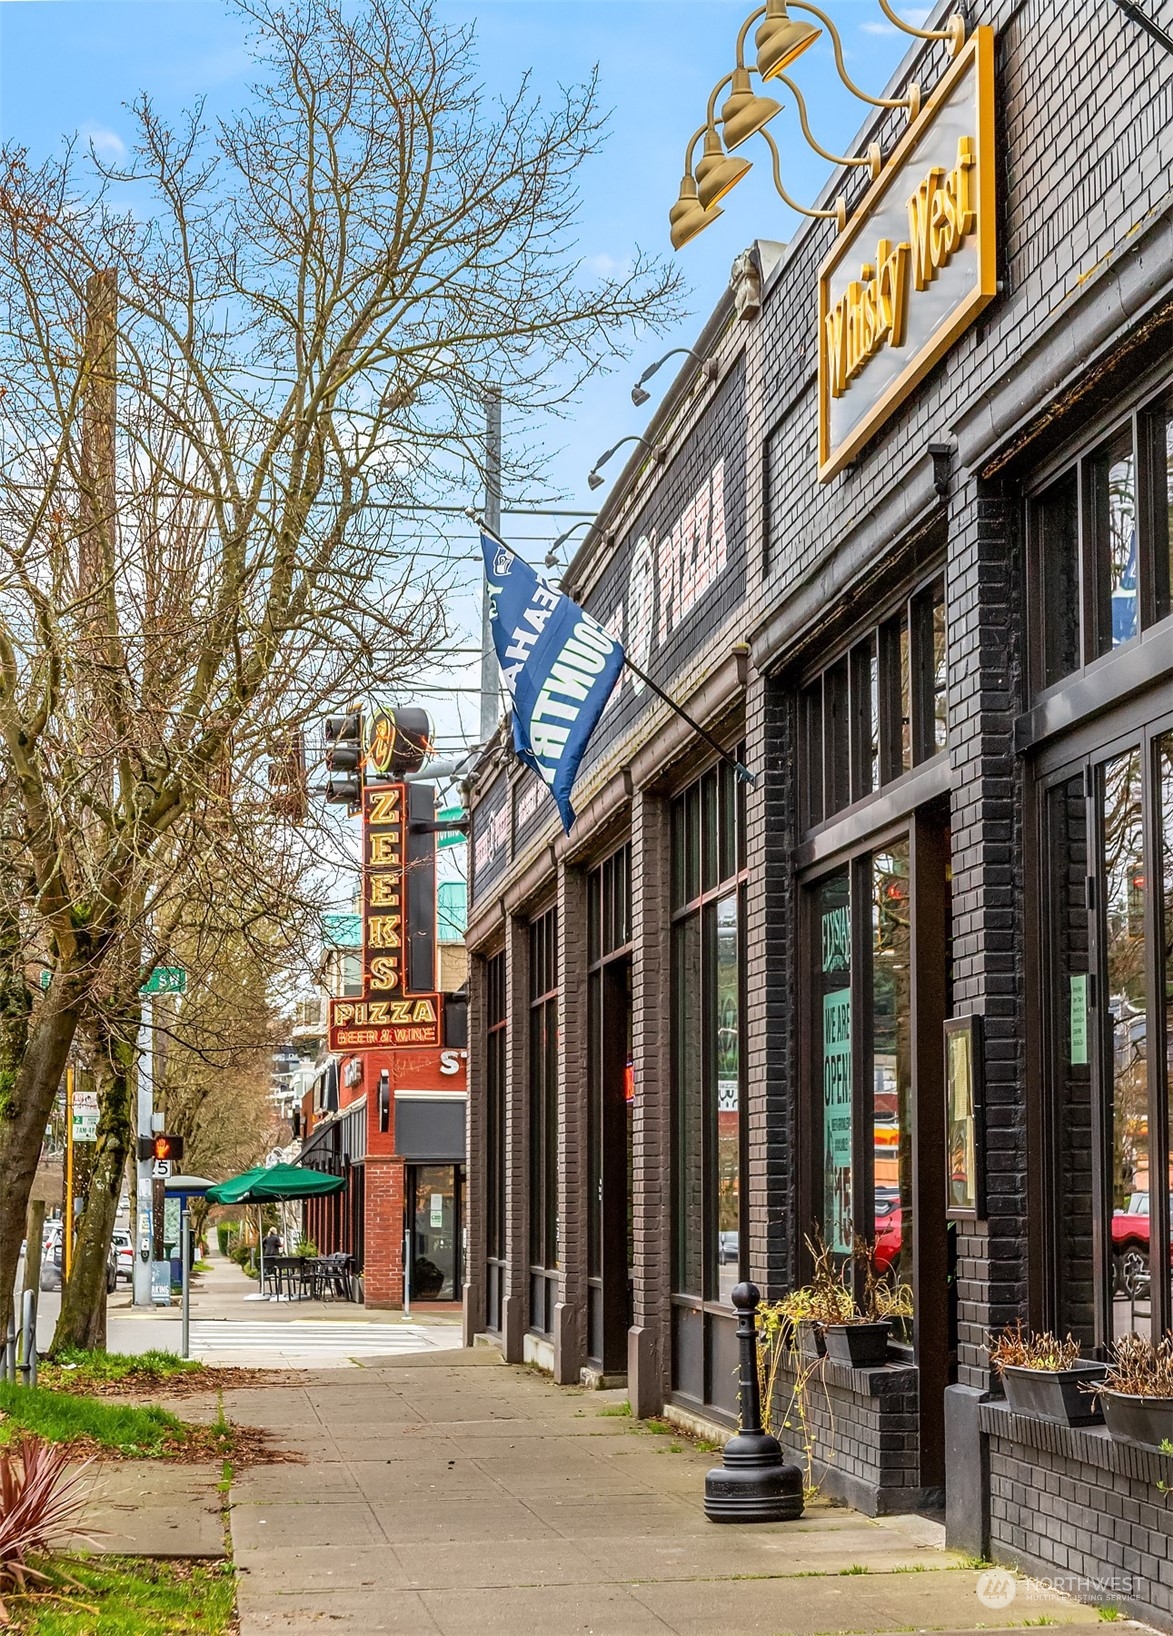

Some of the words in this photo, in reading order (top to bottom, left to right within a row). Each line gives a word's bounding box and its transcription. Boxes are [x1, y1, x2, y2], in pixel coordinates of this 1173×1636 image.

[825, 238, 911, 398] Whisky
[906, 136, 976, 291] West
[658, 457, 727, 648] PIZZA
[369, 790, 401, 991] ZEEKS
[334, 999, 437, 1026] PIZZA
[825, 1006, 836, 1044] WE
[836, 1002, 850, 1042] ARE
[337, 1029, 378, 1046] BEER
[379, 1028, 391, 1043] &
[393, 1026, 436, 1043] WINE
[440, 1050, 467, 1075] S
